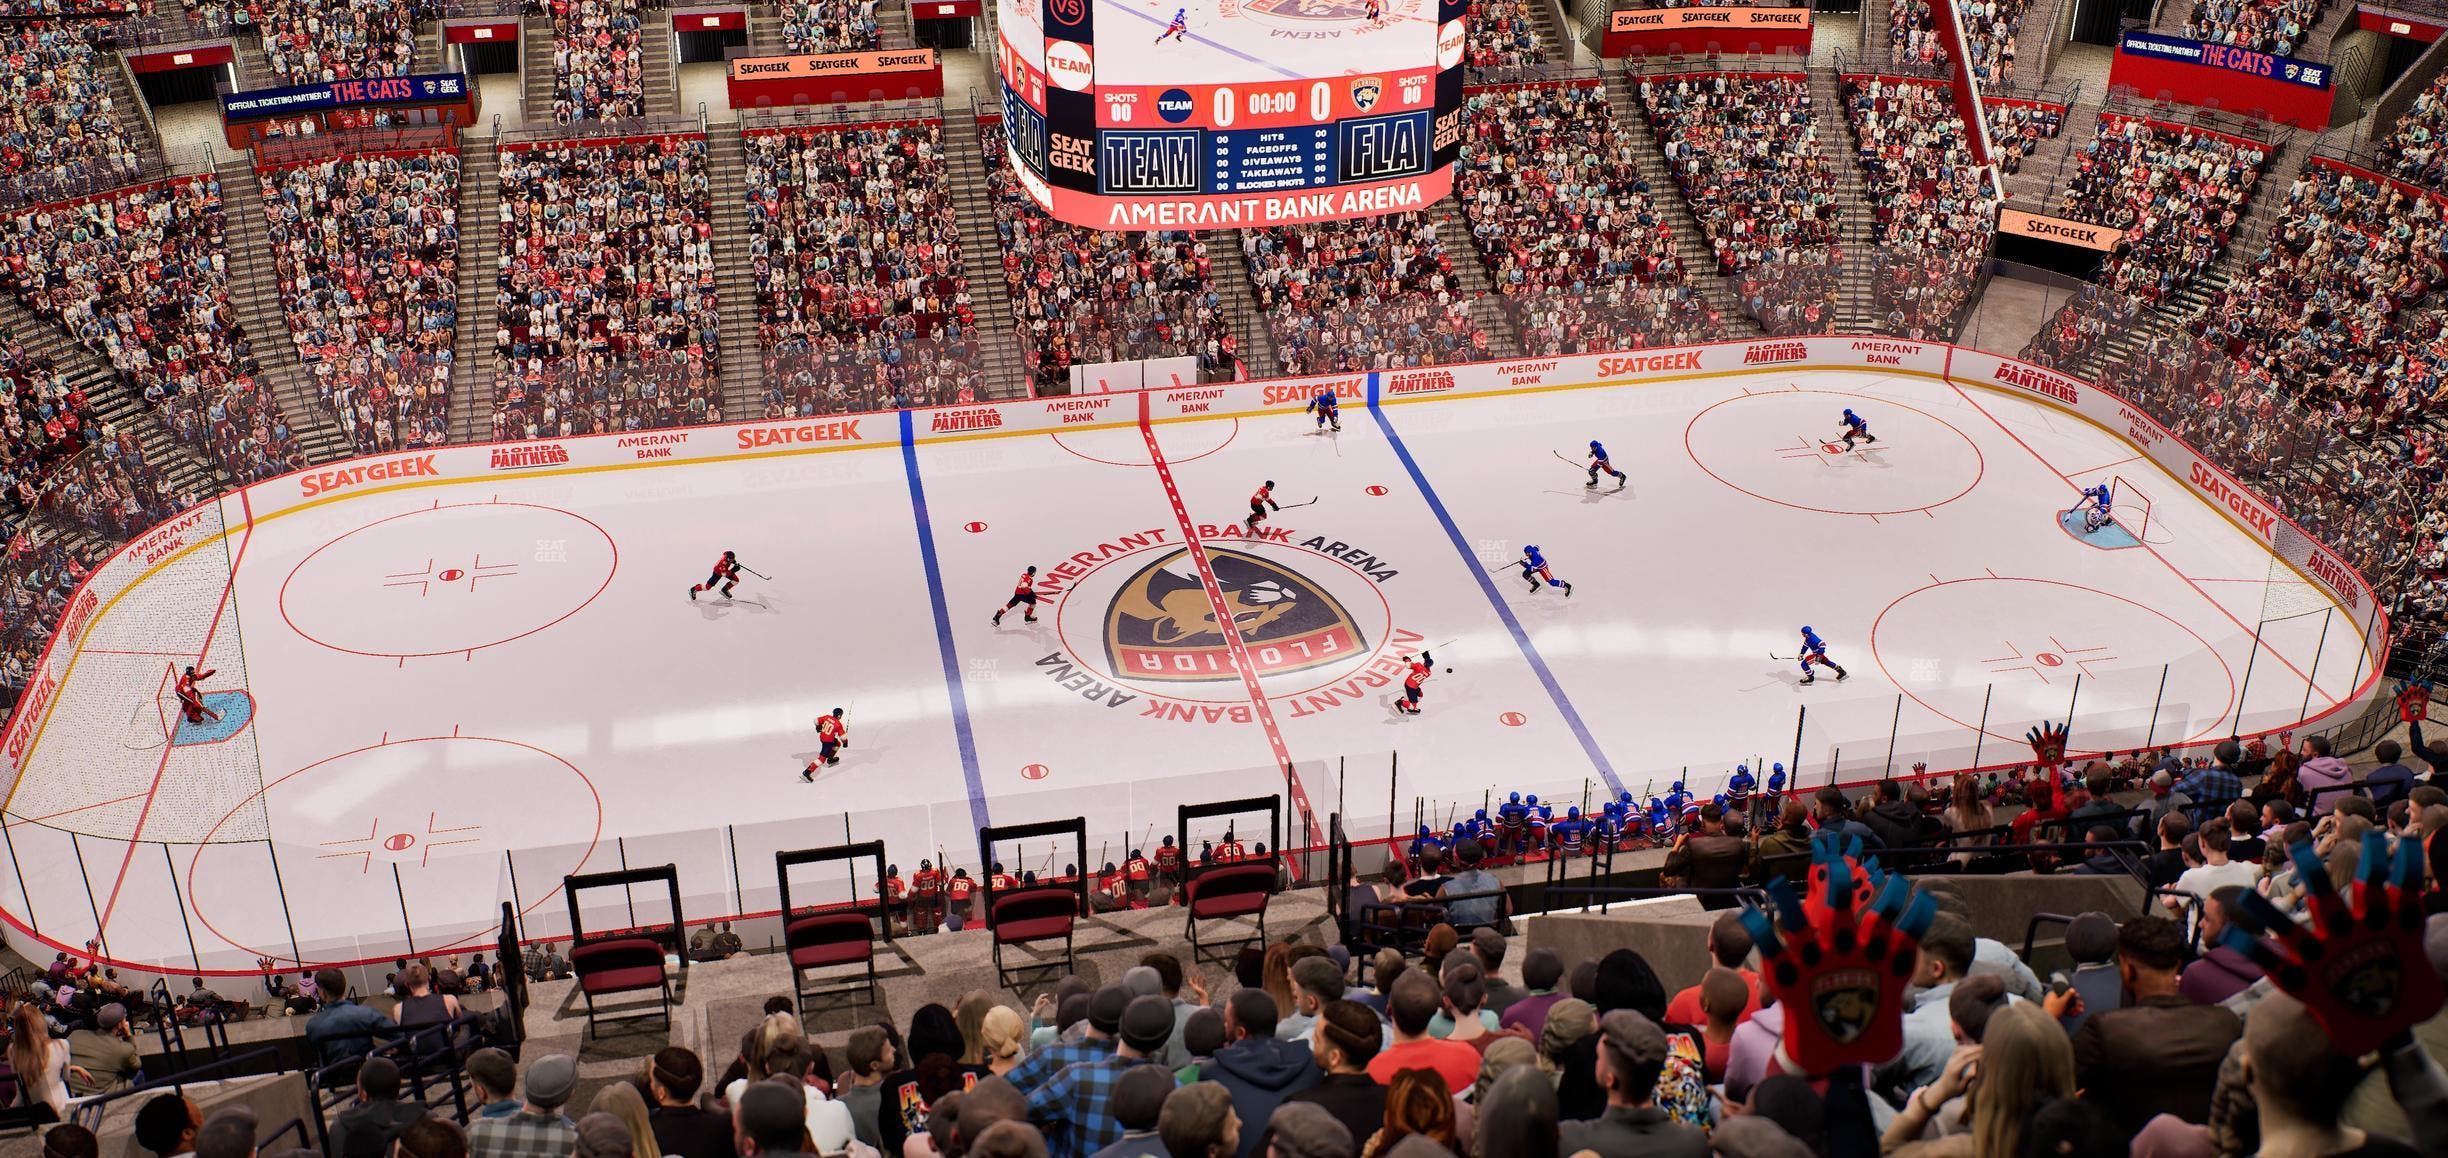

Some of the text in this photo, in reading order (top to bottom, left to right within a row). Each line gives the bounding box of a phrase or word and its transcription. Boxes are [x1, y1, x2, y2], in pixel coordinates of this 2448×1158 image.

[1618, 14, 1664, 26] SEATGEEK
[1682, 12, 1731, 23] SEATGEEK
[1750, 13, 1802, 23] SEATGEEK
[1439, 35, 1464, 54] TEAM
[740, 61, 791, 74] SEATGEEK
[810, 58, 859, 71] SEATGEEK
[878, 54, 926, 67] SEATGEEK
[1048, 56, 1091, 75] TEAM
[2201, 44, 2225, 66] THE
[2227, 50, 2274, 76] CATS
[2304, 67, 2323, 77] SEAT
[440, 79, 457, 87] SEAT
[1398, 75, 1427, 87] SHOTS
[228, 79, 412, 111] OFFICIAL TICKETING PARTNER OF THE CATS
[1104, 94, 1137, 102] SHOTS
[1250, 92, 1296, 114] 00:00
[1311, 82, 1331, 121] 0
[1403, 86, 1422, 104] 00
[1111, 103, 1132, 122] 00
[1159, 101, 1193, 111] TEAM
[1214, 87, 1234, 127] 0
[1435, 107, 1460, 134] SEAT
[1050, 133, 1093, 156] SEAT
[1260, 134, 1284, 142] HITS
[1433, 124, 1460, 152] GEEK
[1247, 144, 1298, 154] FACEOFFS
[1351, 120, 1417, 176] FLA
[1049, 150, 1096, 176] GEEK
[1106, 136, 1194, 188] TEAM
[1242, 156, 1301, 166] GIVEAWAYS
[1241, 167, 1303, 177] TAKEAWAYS
[1236, 180, 1276, 190] BLOCKED
[1276, 178, 1305, 188] SHOTS
[1315, 176, 1326, 184] 00
[1108, 182, 1422, 225] AMERANT BANK ARENA
[2027, 218, 2097, 244] SEATGEEK
[1744, 347, 1808, 363] PANTHERS
[1749, 342, 1806, 352] FLORIDA
[1851, 342, 1922, 356] AMERANT
[1598, 350, 1703, 377] SEATGEEK
[1866, 354, 1902, 365] BANK
[1392, 371, 1452, 381] FLORIDA
[1497, 362, 1558, 375] AMERANT
[2001, 362, 2076, 390] FLORIDA
[1388, 376, 1455, 394] PANTHERS
[1511, 374, 1541, 385] BANK
[1993, 366, 2079, 405] PANTHERS
[1046, 398, 1112, 412] AMERANT
[1166, 390, 1224, 403] AMERANT
[934, 408, 997, 419] FLORIDA
[1181, 403, 1210, 414] BANK
[931, 413, 1002, 432] PANTHERS
[1063, 412, 1094, 423] BANK
[2119, 407, 2164, 444] AMERANT
[617, 433, 689, 448] AMERANT
[738, 419, 862, 449] SEATGEEK
[2129, 427, 2150, 449] BANK
[492, 444, 563, 454] FLORIDA
[637, 447, 672, 459] BANK
[490, 449, 569, 468] PANTHERS
[301, 455, 440, 497] SEATGEEK
[2189, 461, 2276, 541] SEATGEEK
[128, 512, 202, 562] AMERANT
[147, 537, 184, 564] BANK
[1034, 524, 1399, 605] AMERANT BANK ARENA
[1035, 651, 1138, 709] ARENA
[8, 661, 56, 769] SEATGEEK
[1138, 700, 1253, 724] BANK
[1130, 861, 1145, 872] 00
[1162, 856, 1176, 866] 00
[954, 881, 969, 892] 00
